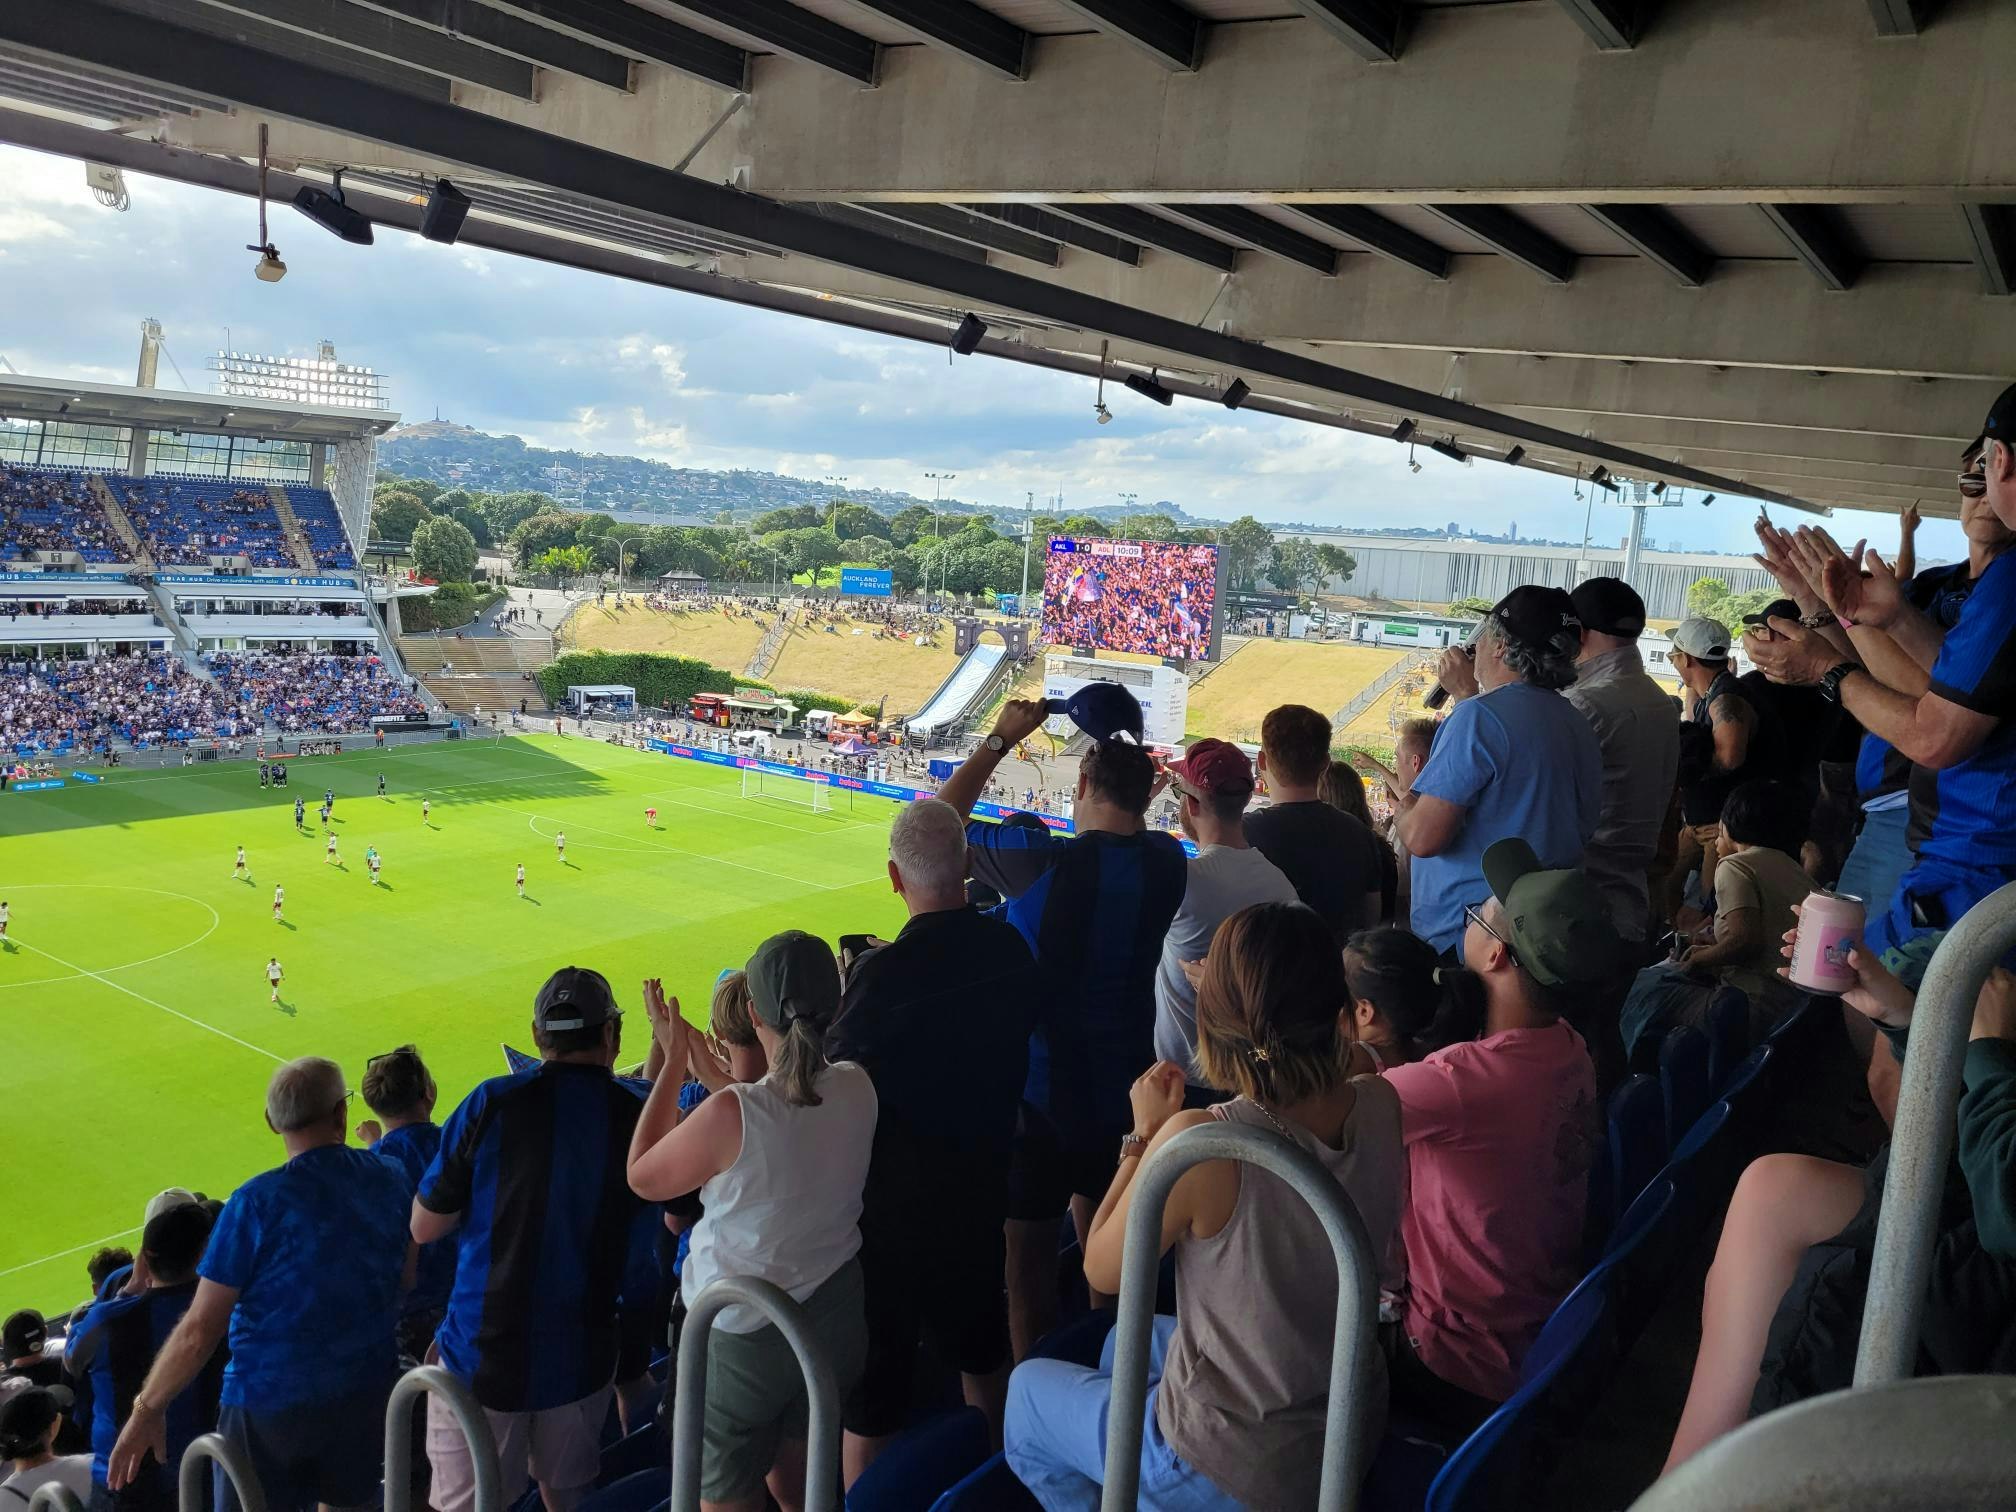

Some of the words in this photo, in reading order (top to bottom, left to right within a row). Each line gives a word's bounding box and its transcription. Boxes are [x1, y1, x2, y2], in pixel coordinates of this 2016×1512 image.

[1117, 546, 1139, 555] 10:09
[58, 574, 69, 582] your
[842, 575, 878, 583] AUCKLAND
[859, 582, 890, 590] FOREVER
[1048, 688, 1065, 697] ZEIL
